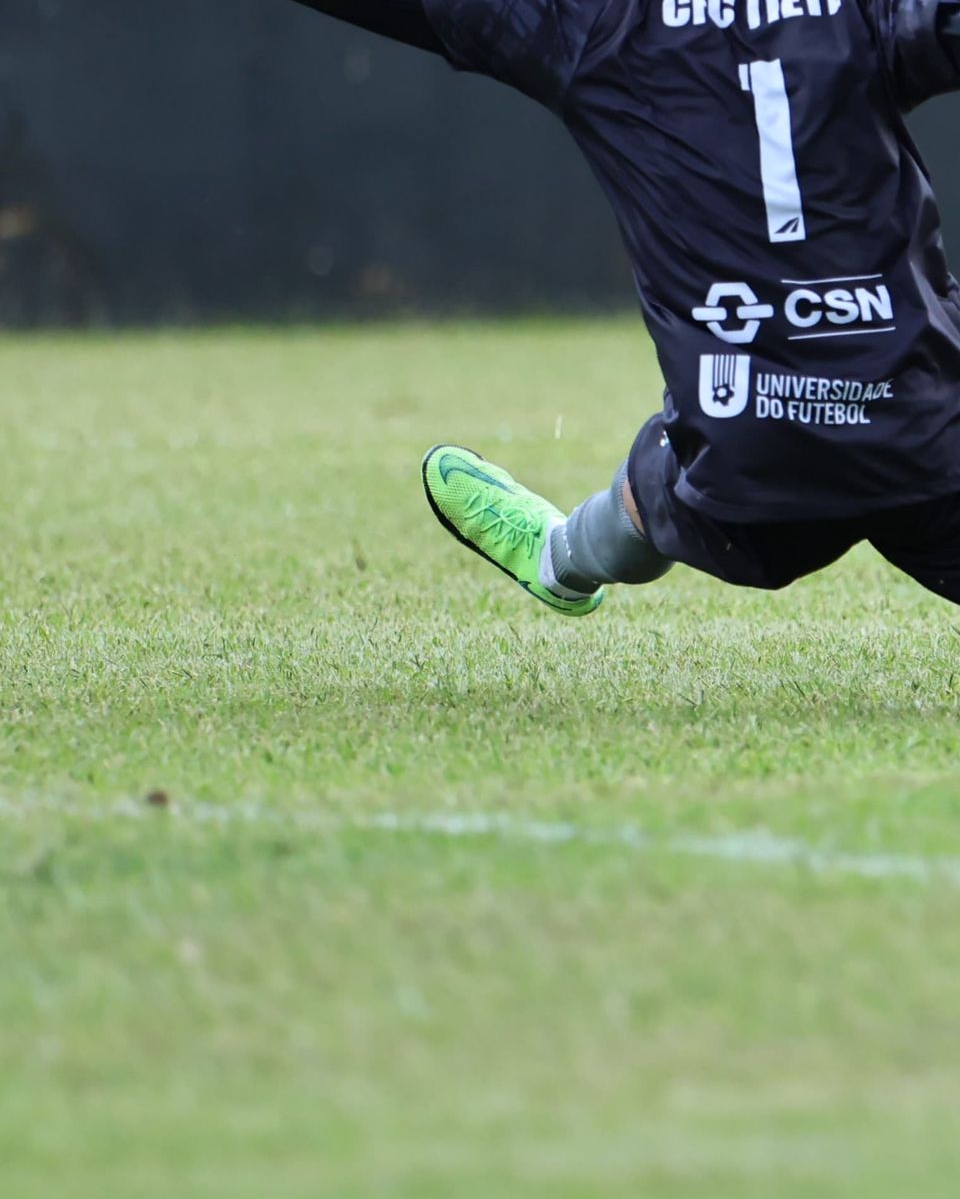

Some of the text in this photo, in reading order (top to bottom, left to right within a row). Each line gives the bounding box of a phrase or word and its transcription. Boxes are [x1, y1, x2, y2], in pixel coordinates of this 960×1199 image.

[738, 58, 806, 244] 1
[784, 285, 894, 328] CSN
[756, 373, 894, 402] UNIVERSIDADE
[755, 396, 871, 425] DO FUTEBOL
